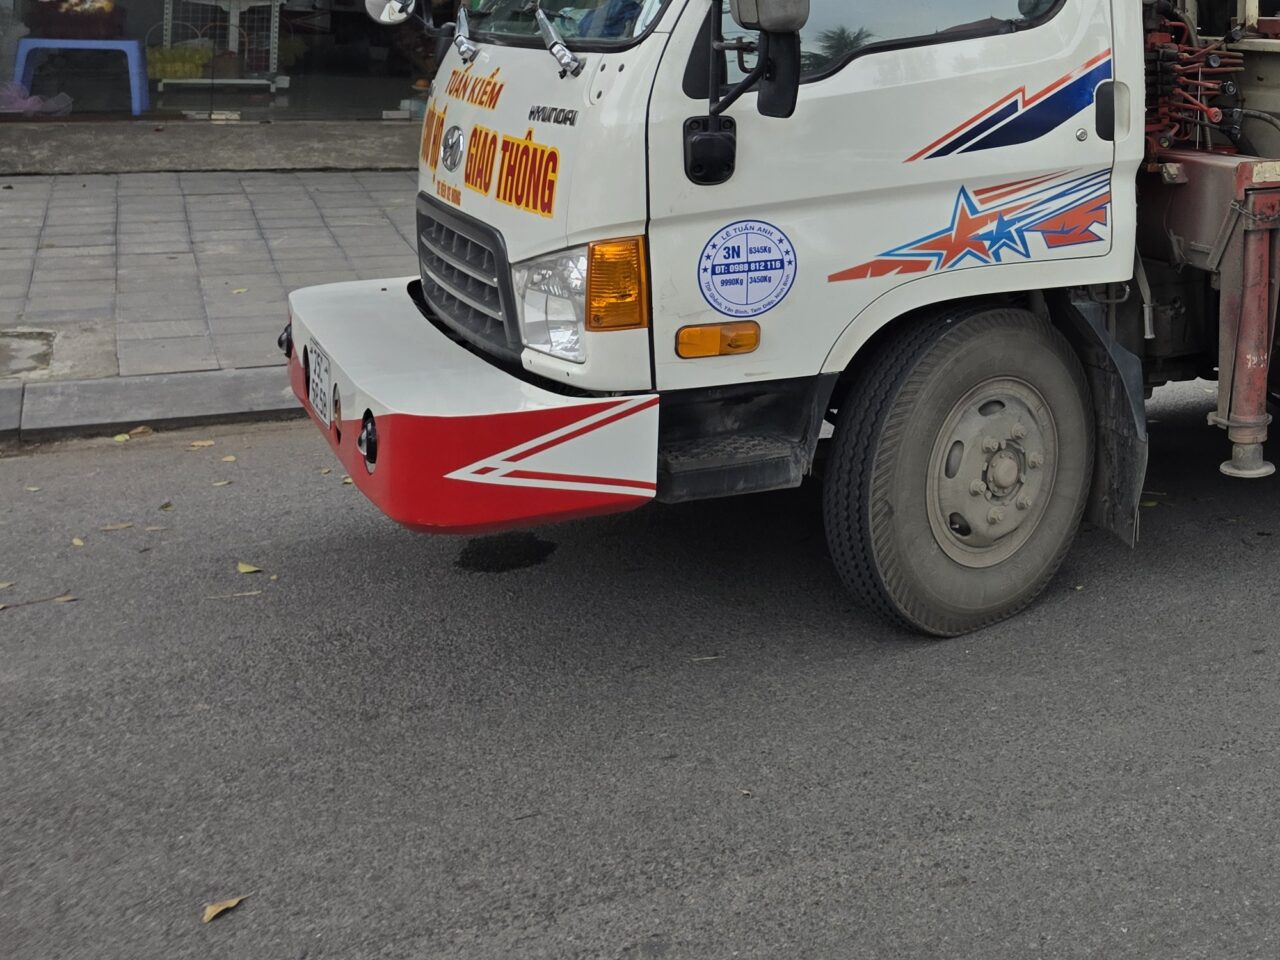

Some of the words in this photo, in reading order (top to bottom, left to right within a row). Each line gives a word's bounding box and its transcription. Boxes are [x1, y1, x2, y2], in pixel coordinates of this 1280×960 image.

[464, 124, 499, 197] GIAO
[495, 127, 561, 218] THÔNG
[723, 245, 741, 260] 3N
[750, 261, 765, 271] 812
